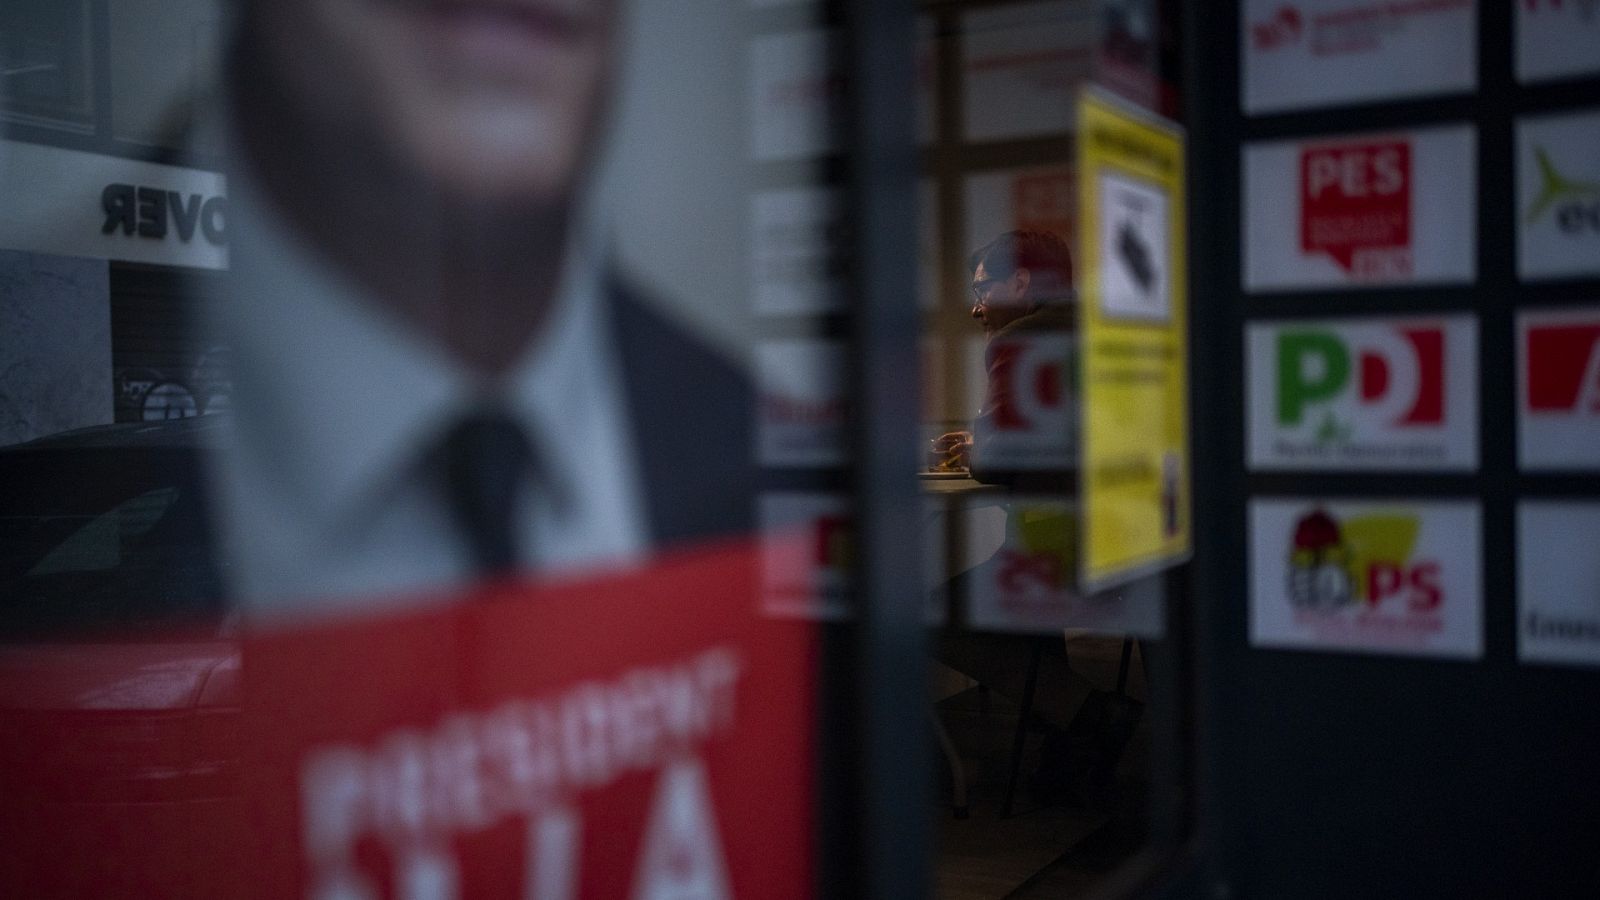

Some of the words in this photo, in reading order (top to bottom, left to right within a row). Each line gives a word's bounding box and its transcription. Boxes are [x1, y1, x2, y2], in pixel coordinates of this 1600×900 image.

[1307, 149, 1404, 199] PES
[1277, 325, 1425, 427] PD
[1366, 561, 1444, 614] PS
